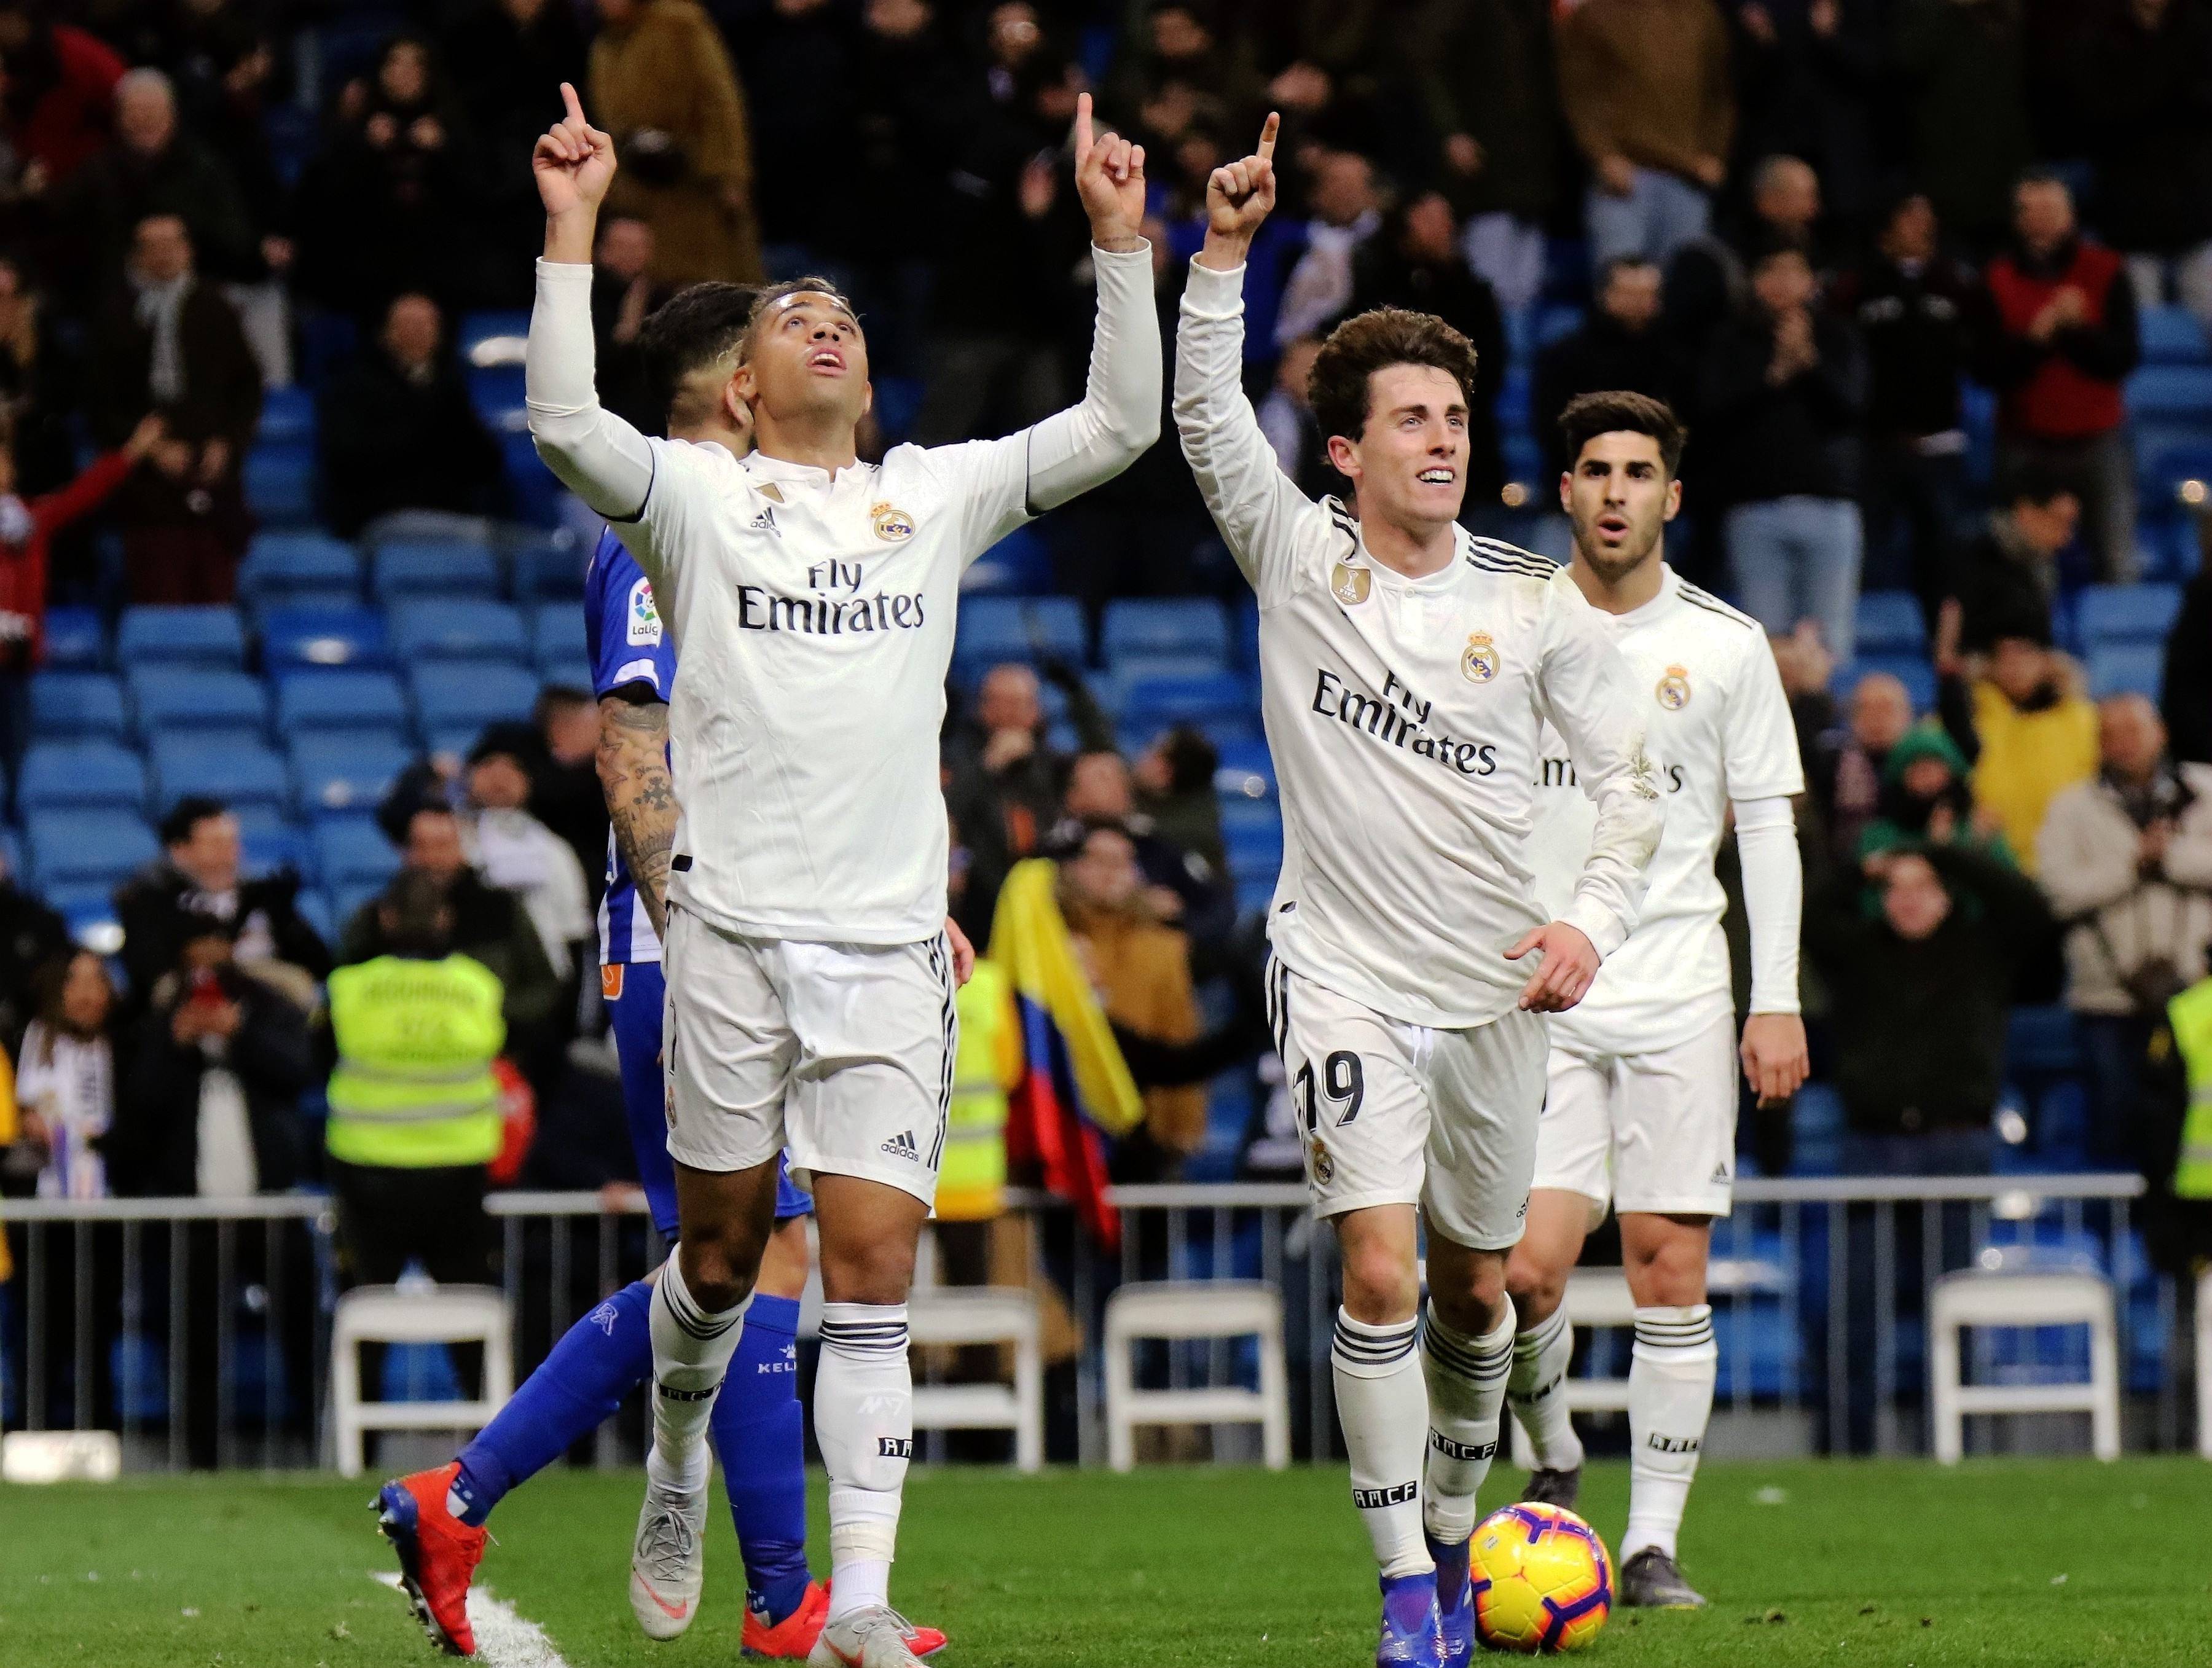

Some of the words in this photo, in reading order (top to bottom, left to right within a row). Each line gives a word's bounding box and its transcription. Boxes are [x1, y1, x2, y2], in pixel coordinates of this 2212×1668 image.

[750, 519, 782, 538] adis
[806, 558, 862, 593] Fly
[736, 584, 924, 635] Emirates
[632, 624, 658, 636] LaLig
[1384, 670, 1432, 724] Fly
[1312, 667, 1497, 776] Emirates
[1293, 1050, 1364, 1134] 19
[880, 1143, 919, 1162] adidas
[757, 1360, 797, 1374] KEL
[883, 1438, 913, 1457] RM
[1431, 1427, 1496, 1460] RMCF
[1354, 1481, 1416, 1508] RMCF
